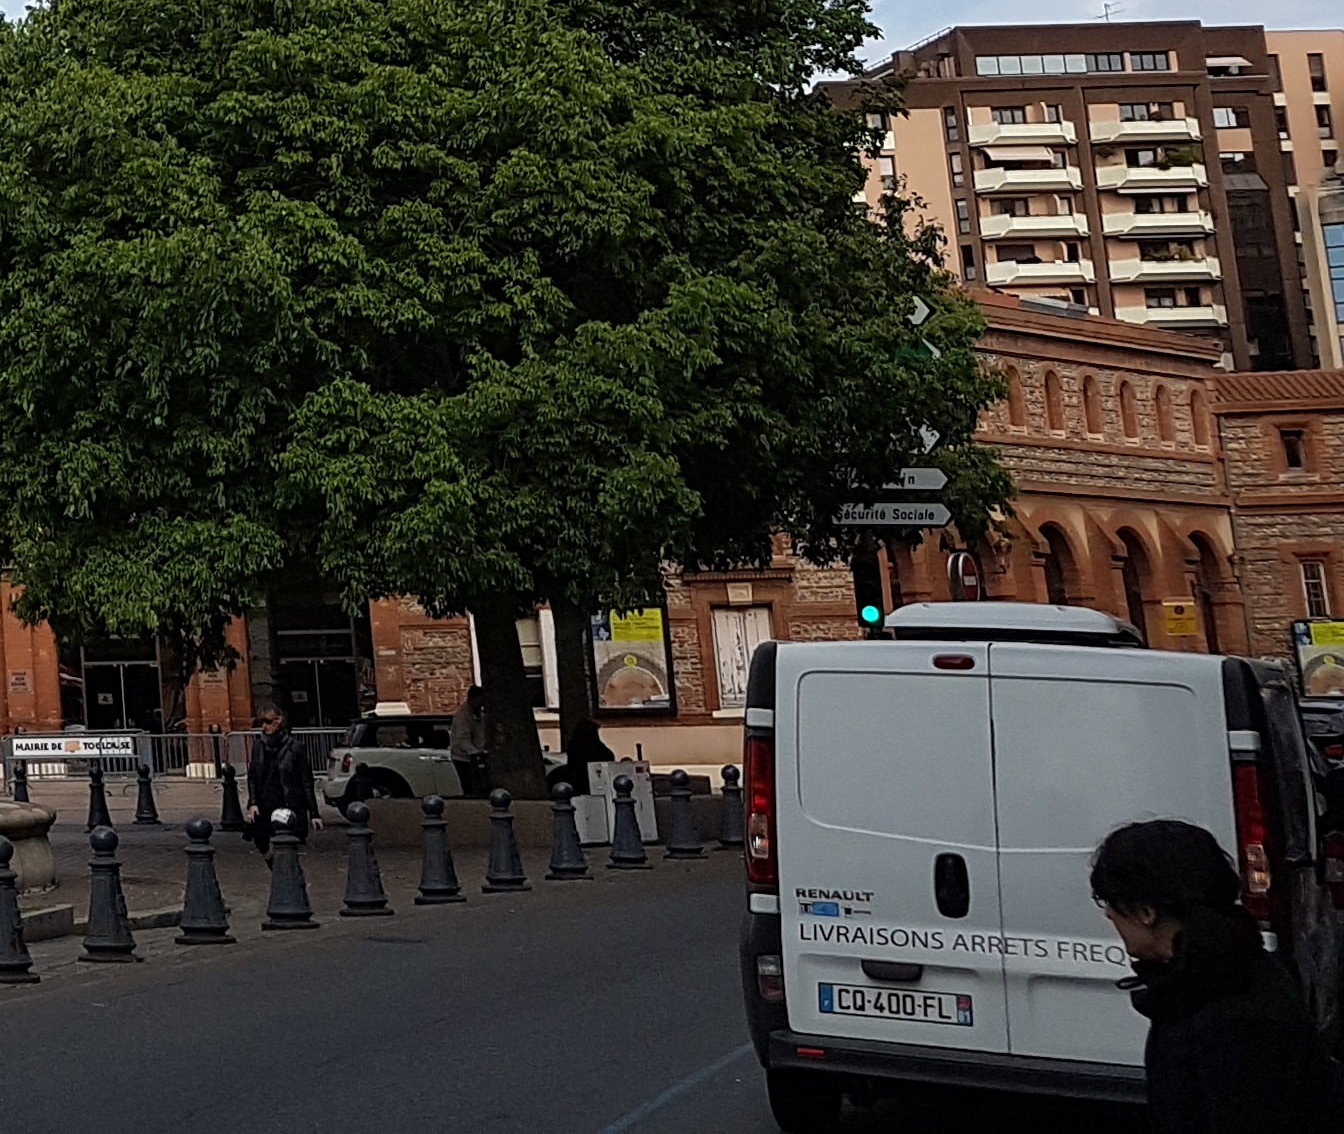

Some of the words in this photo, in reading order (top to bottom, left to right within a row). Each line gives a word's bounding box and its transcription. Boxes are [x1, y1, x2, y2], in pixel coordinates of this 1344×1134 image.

[892, 508, 935, 521] Sociale
[15, 742, 49, 751] MAIRIE
[51, 742, 63, 751] DE
[83, 741, 131, 751] TOULOUSE
[795, 888, 875, 902] RENAULT
[799, 923, 944, 949] LIVRAISONS
[952, 934, 1049, 958] ARRETS
[1056, 941, 1127, 967] FREQ
[837, 988, 952, 1020] CQ-400-FL
